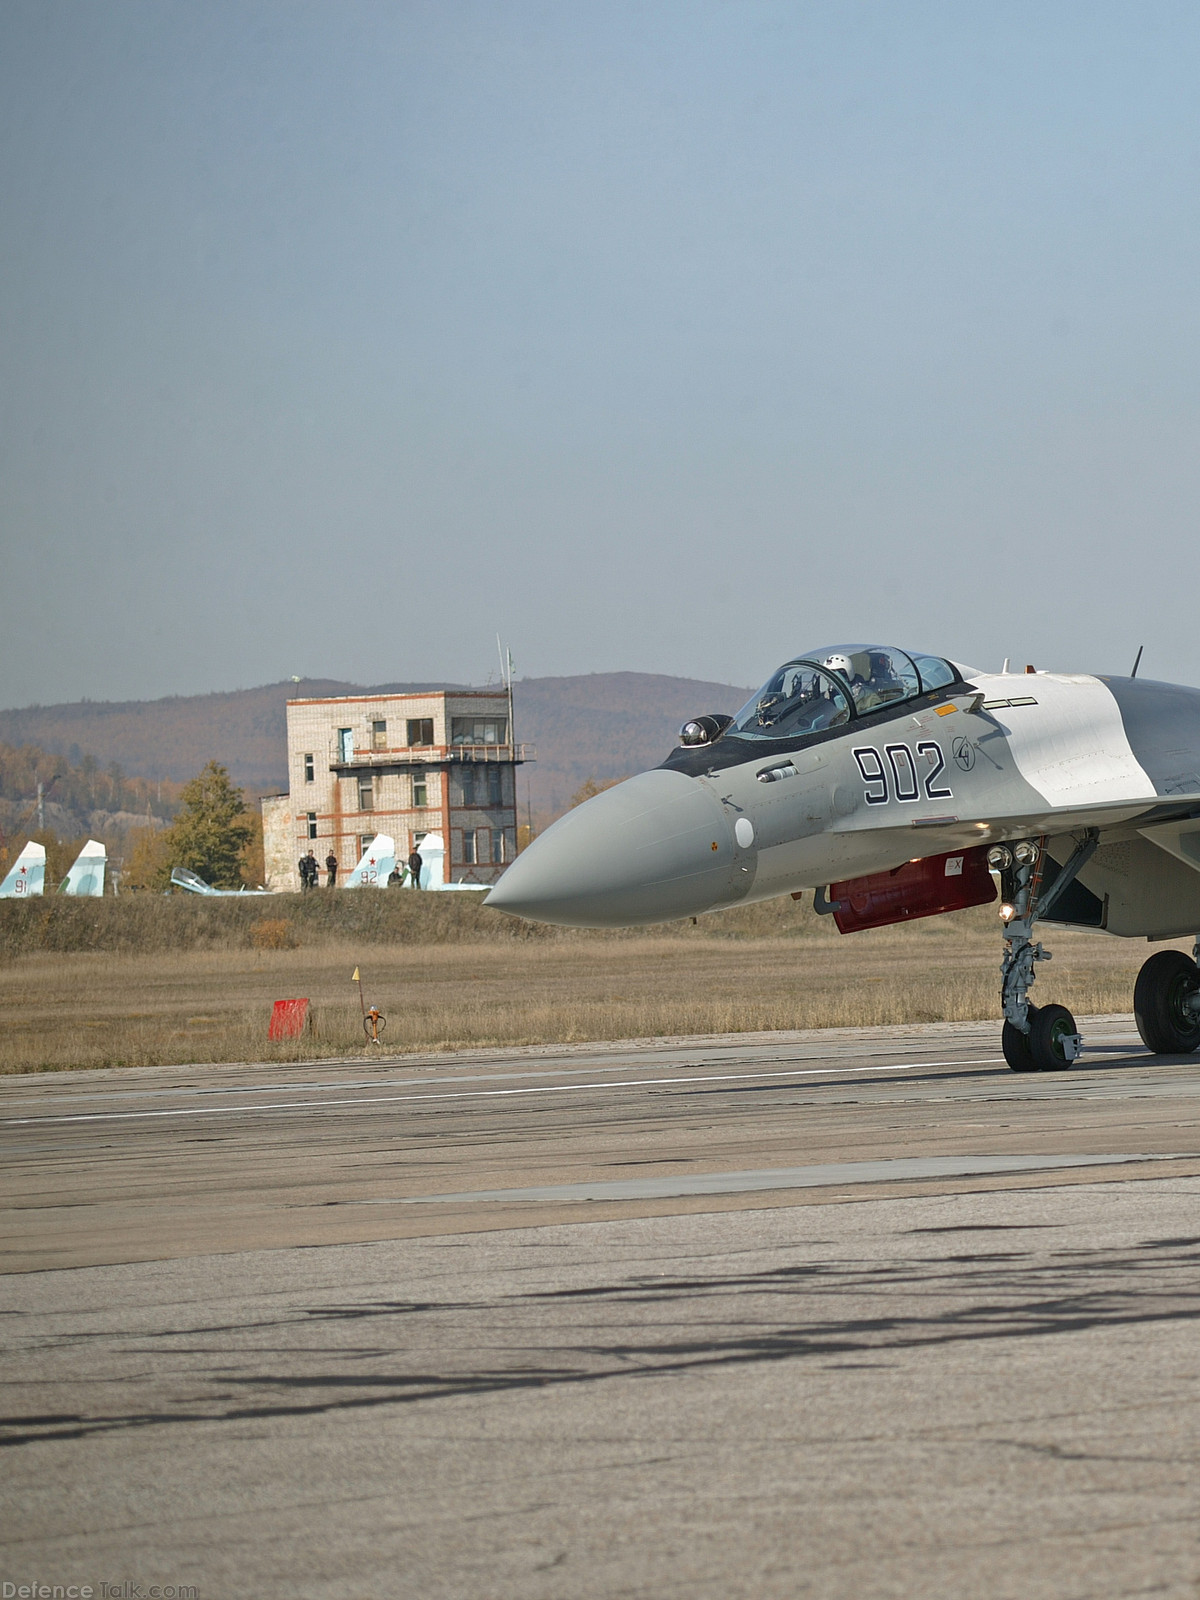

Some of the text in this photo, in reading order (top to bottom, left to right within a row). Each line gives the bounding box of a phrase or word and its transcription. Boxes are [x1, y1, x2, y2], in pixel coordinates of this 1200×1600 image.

[852, 740, 954, 806] 902
[361, 870, 378, 884] 92
[15, 879, 27, 893] 91
